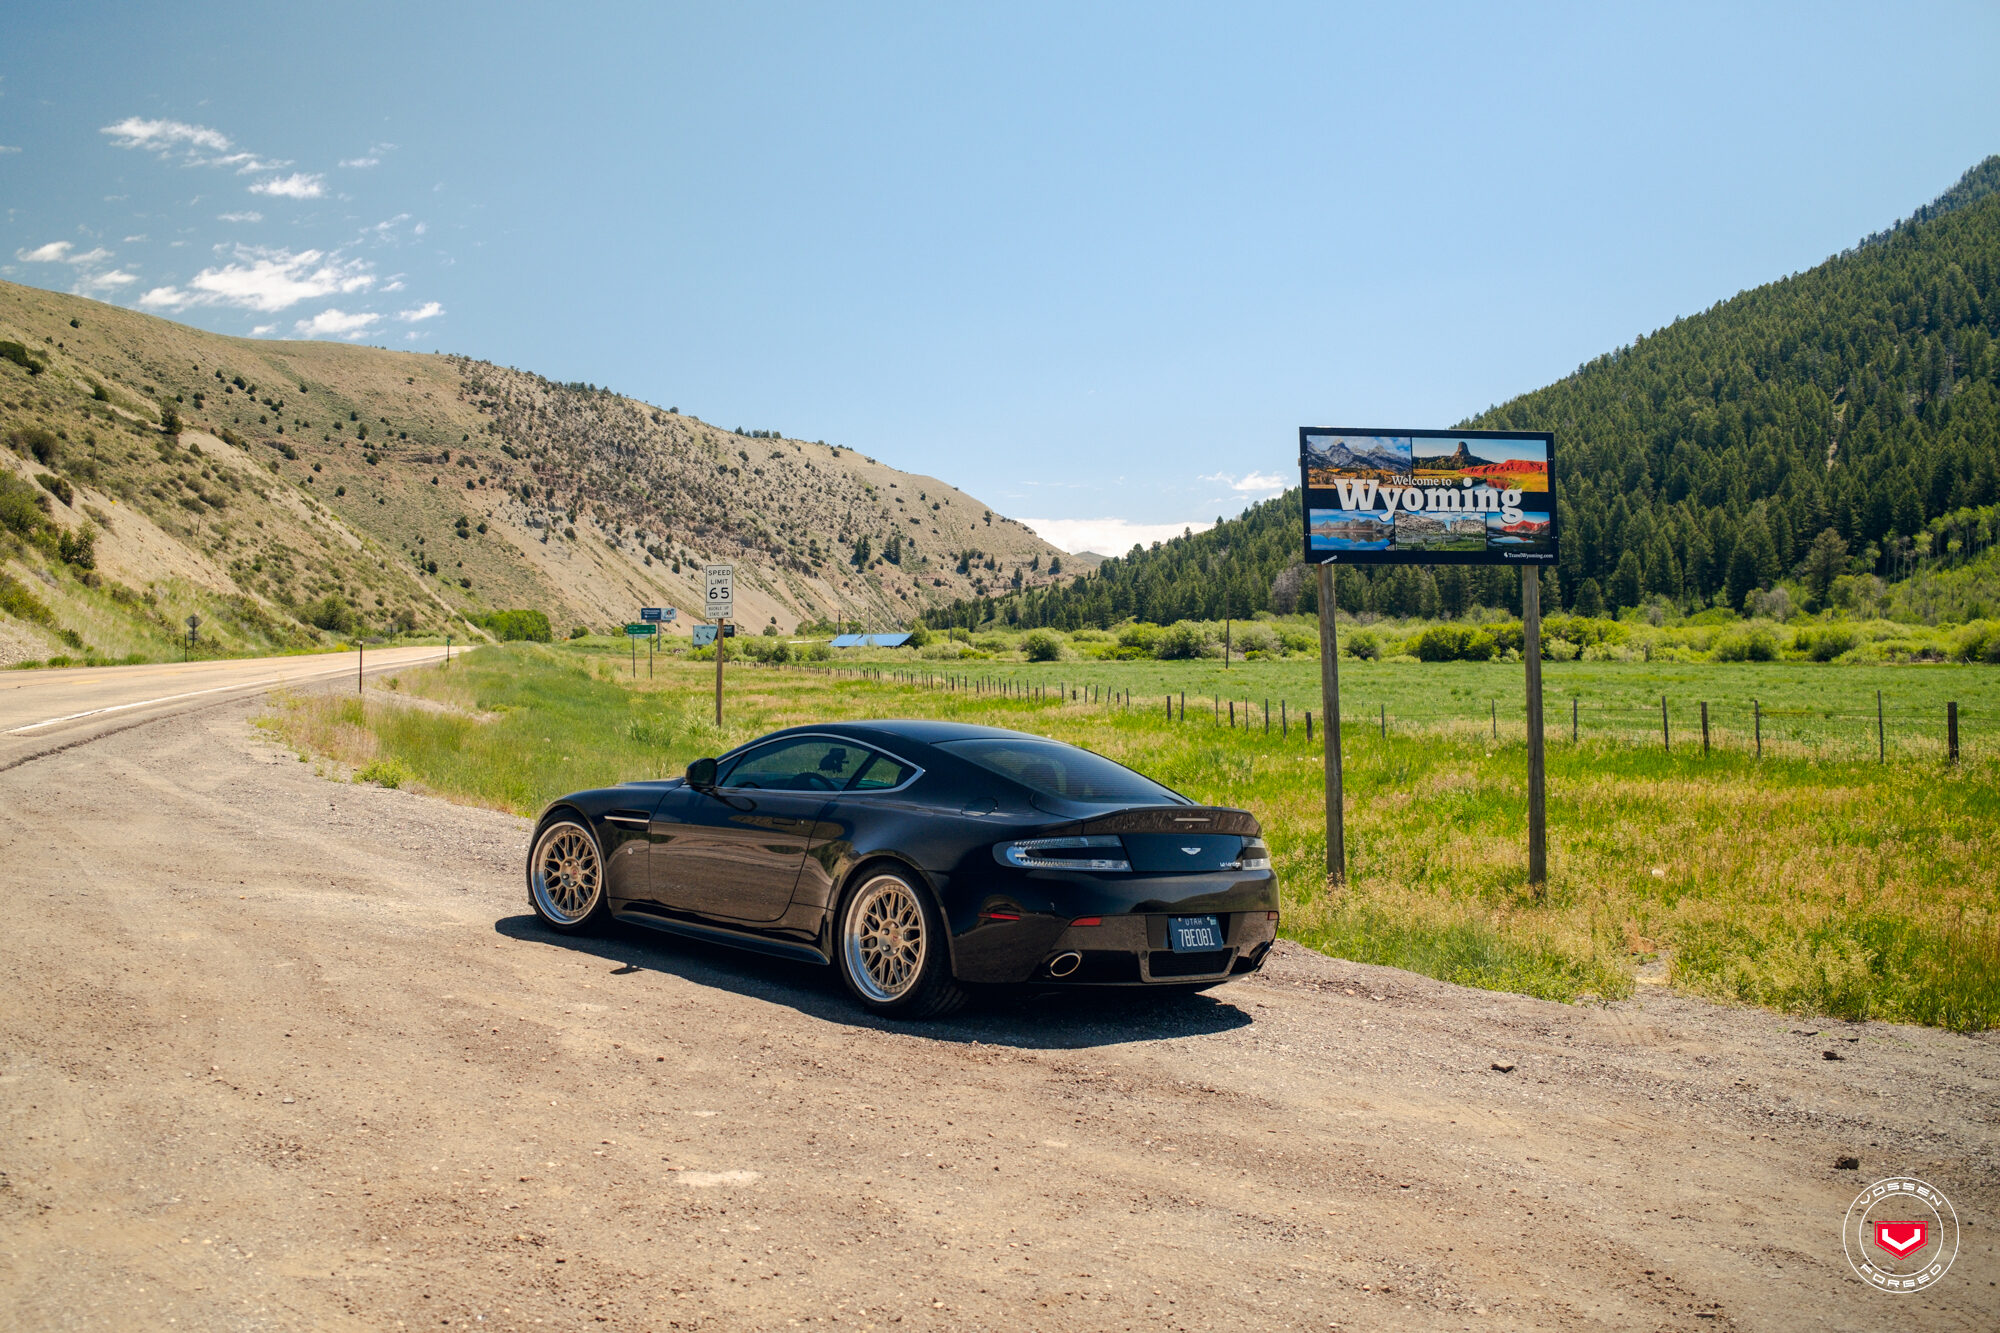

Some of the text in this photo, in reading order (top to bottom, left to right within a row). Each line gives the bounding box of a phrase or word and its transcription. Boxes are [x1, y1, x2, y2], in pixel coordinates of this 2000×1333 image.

[1391, 474, 1452, 486] Welcome to
[1334, 477, 1523, 524] Wyoming
[709, 587, 730, 600] 65
[1184, 918, 1203, 926] UTAH
